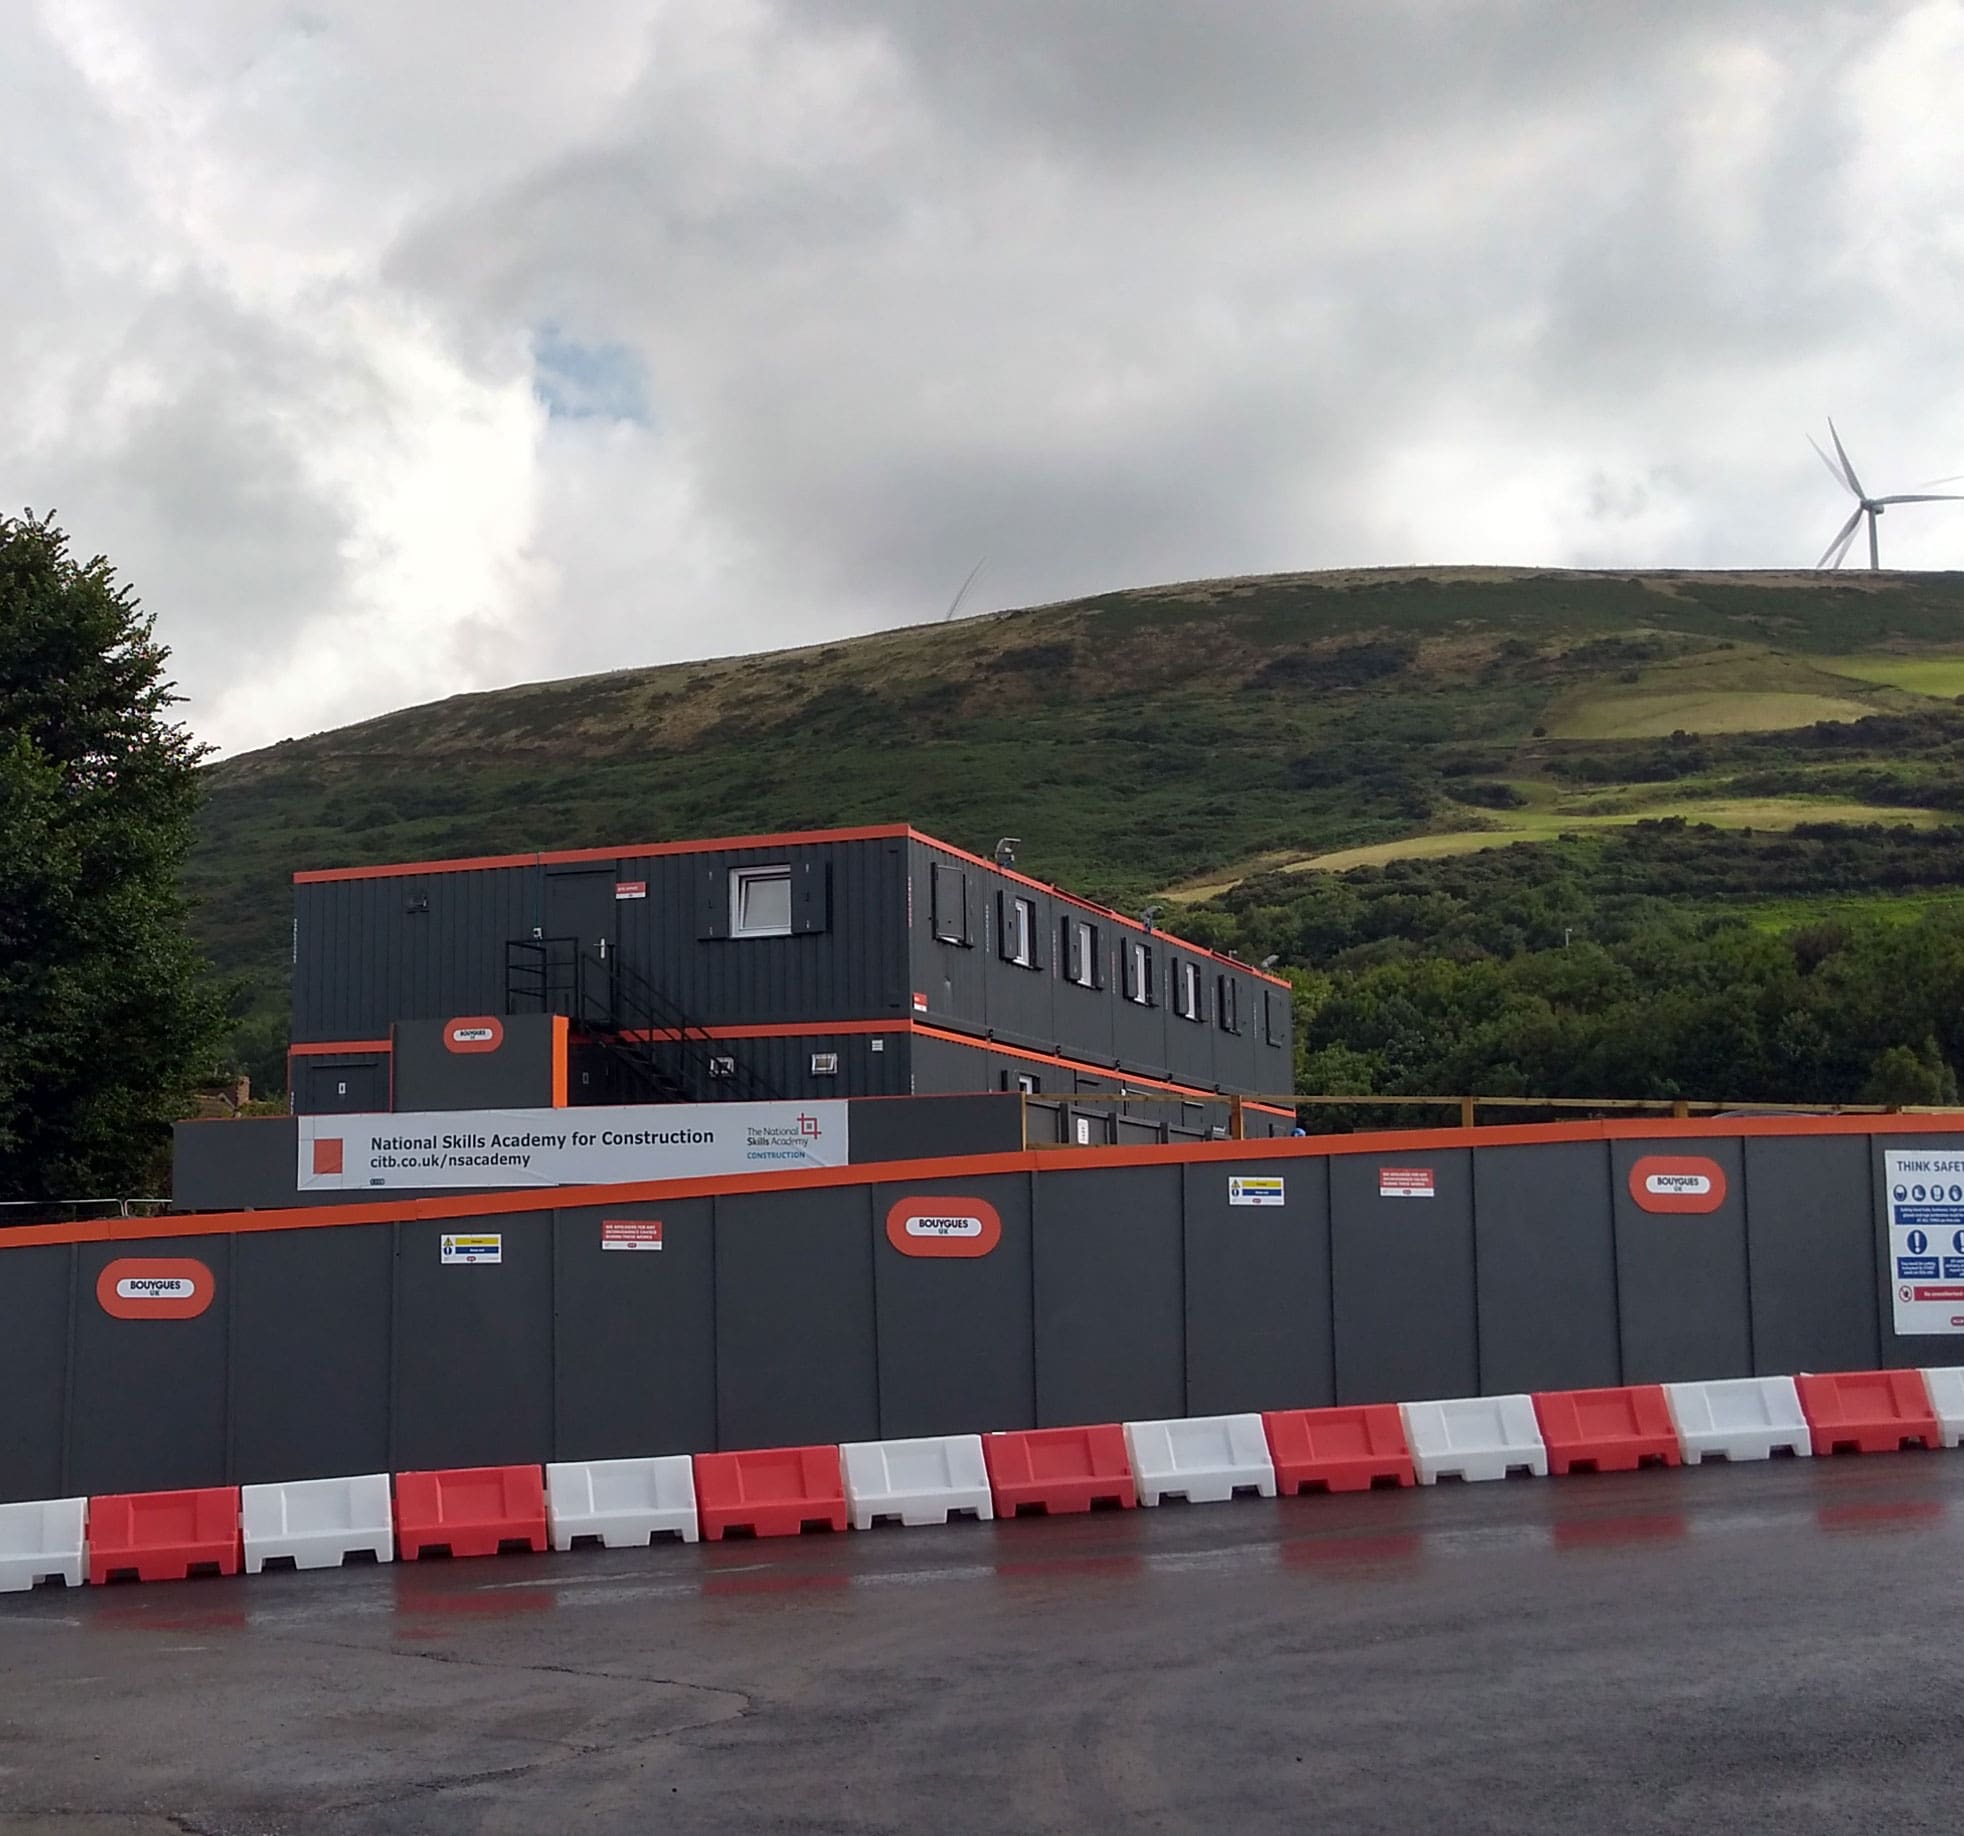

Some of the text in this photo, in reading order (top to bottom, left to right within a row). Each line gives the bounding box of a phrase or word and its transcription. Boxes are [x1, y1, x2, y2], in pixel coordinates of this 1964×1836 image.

[747, 1126, 799, 1136] The National
[371, 1128, 715, 1151] National Skills Academy for Construction
[746, 1136, 809, 1147] Skills Academy
[747, 1151, 806, 1160] CONSTRUCTION
[370, 1153, 531, 1169] citb.co.uk/nsacademy
[1896, 1161, 1930, 1172] THINK
[1657, 1177, 1700, 1186] BOUYGUES
[919, 1219, 969, 1228] BOUYGUES
[130, 1280, 182, 1290] BOUYGUES
